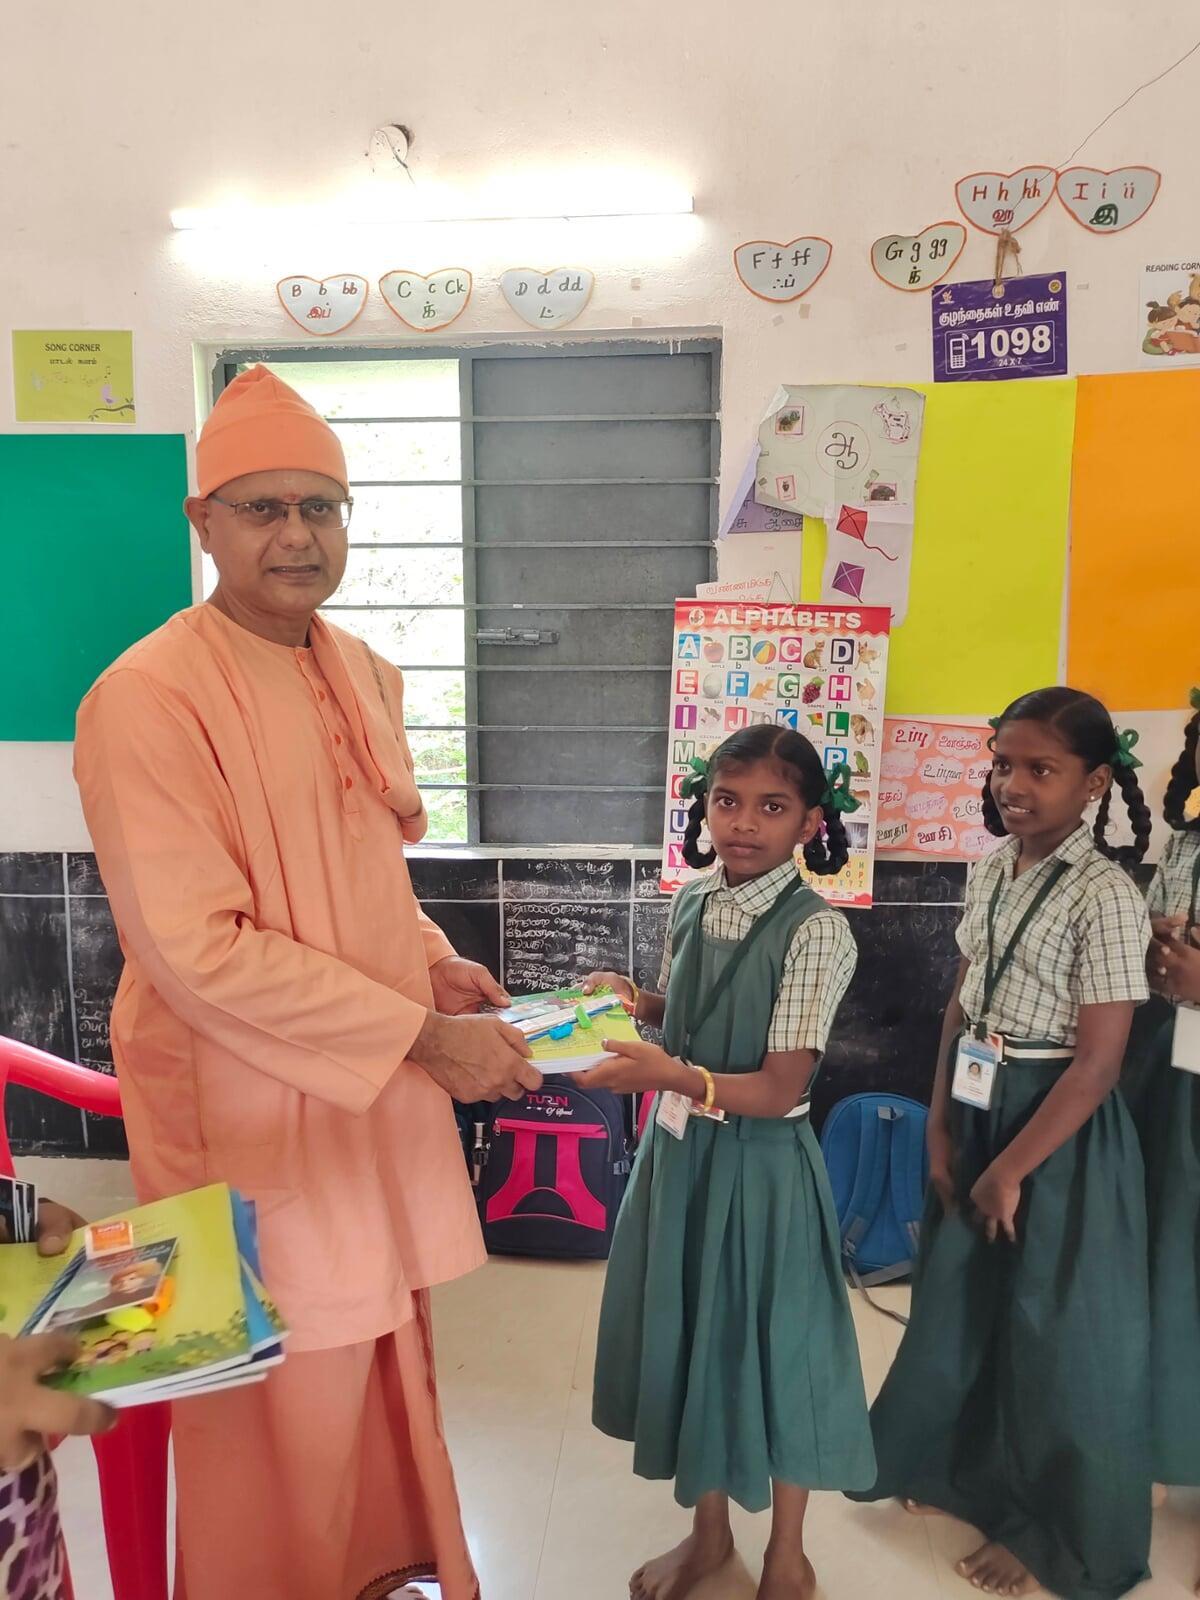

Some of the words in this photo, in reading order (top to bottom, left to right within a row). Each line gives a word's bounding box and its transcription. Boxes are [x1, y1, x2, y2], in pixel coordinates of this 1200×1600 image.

[972, 185, 987, 201] H
[999, 182, 1008, 201] h
[1022, 179, 1040, 199] hh
[1072, 183, 1089, 200] I
[1101, 183, 1106, 199] i
[1123, 182, 1135, 199] ii
[753, 252, 765, 269] F
[772, 253, 782, 269] f
[792, 248, 811, 267] ff
[885, 241, 903, 260] G
[910, 242, 921, 262] g
[929, 239, 947, 259] gg
[1145, 263, 1179, 272] READING
[292, 285, 302, 297] B
[318, 282, 327, 296] b
[342, 282, 358, 295] bb
[397, 281, 411, 298] C
[428, 282, 436, 294] c
[515, 282, 528, 296] D
[538, 279, 549, 294] d
[559, 276, 583, 292] dd
[939, 303, 1003, 327] குழந்தைகள்
[1004, 300, 1034, 319] உதவி
[1035, 297, 1060, 313] எண்
[45, 343, 67, 352] SONG
[69, 343, 101, 352] CORNER
[970, 325, 1051, 359] 1098
[999, 359, 1008, 367] 24
[825, 432, 859, 470] ஆ
[713, 607, 862, 630] ALPHABETS
[679, 635, 699, 658] A
[731, 636, 748, 659] B
[781, 639, 801, 661] C
[832, 641, 852, 663] D
[735, 661, 742, 669] b
[680, 671, 697, 693] E
[730, 673, 746, 694] F
[779, 675, 799, 698] G
[830, 677, 849, 699] H
[683, 707, 689, 728] I
[728, 709, 744, 729] J
[778, 711, 796, 730] K
[829, 713, 846, 735] L
[675, 742, 694, 762] M
[826, 748, 845, 771] P
